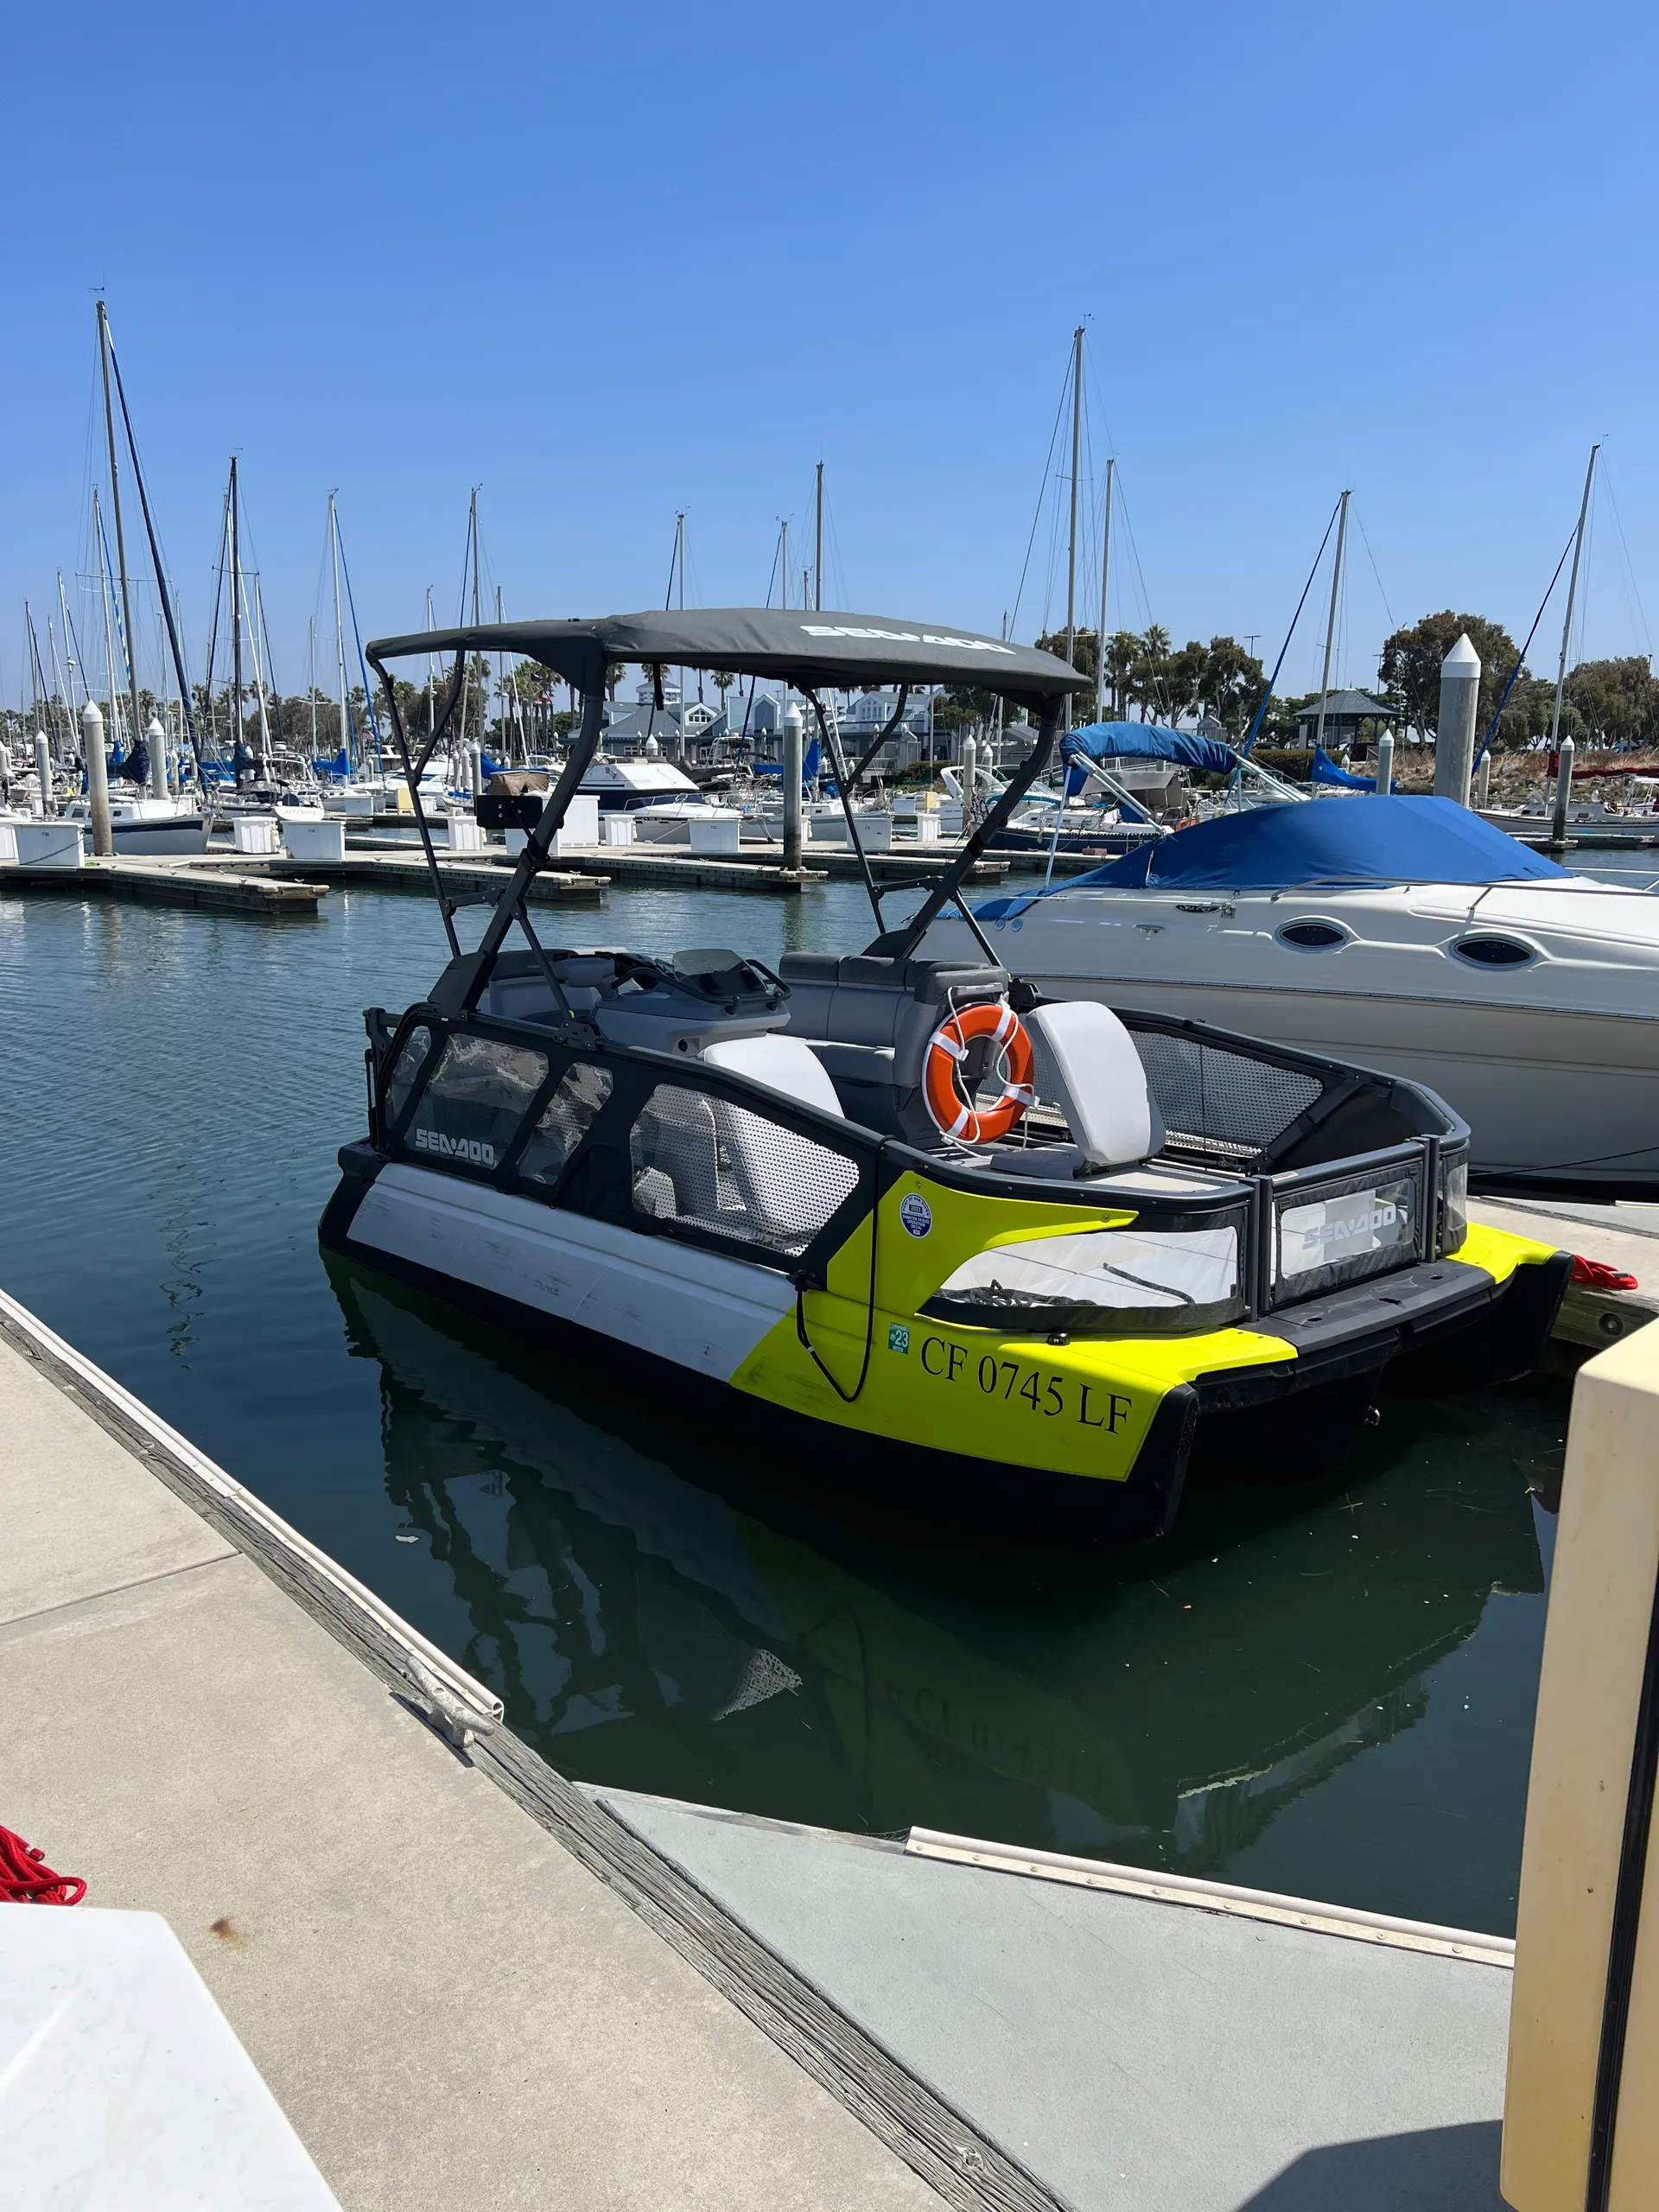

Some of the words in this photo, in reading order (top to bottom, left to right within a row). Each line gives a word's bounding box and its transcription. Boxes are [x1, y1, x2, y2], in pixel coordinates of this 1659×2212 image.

[894, 1330, 909, 1348] 23
[920, 1336, 969, 1382] CF
[977, 1355, 1065, 1417] 0745
[1076, 1382, 1134, 1436] LF
